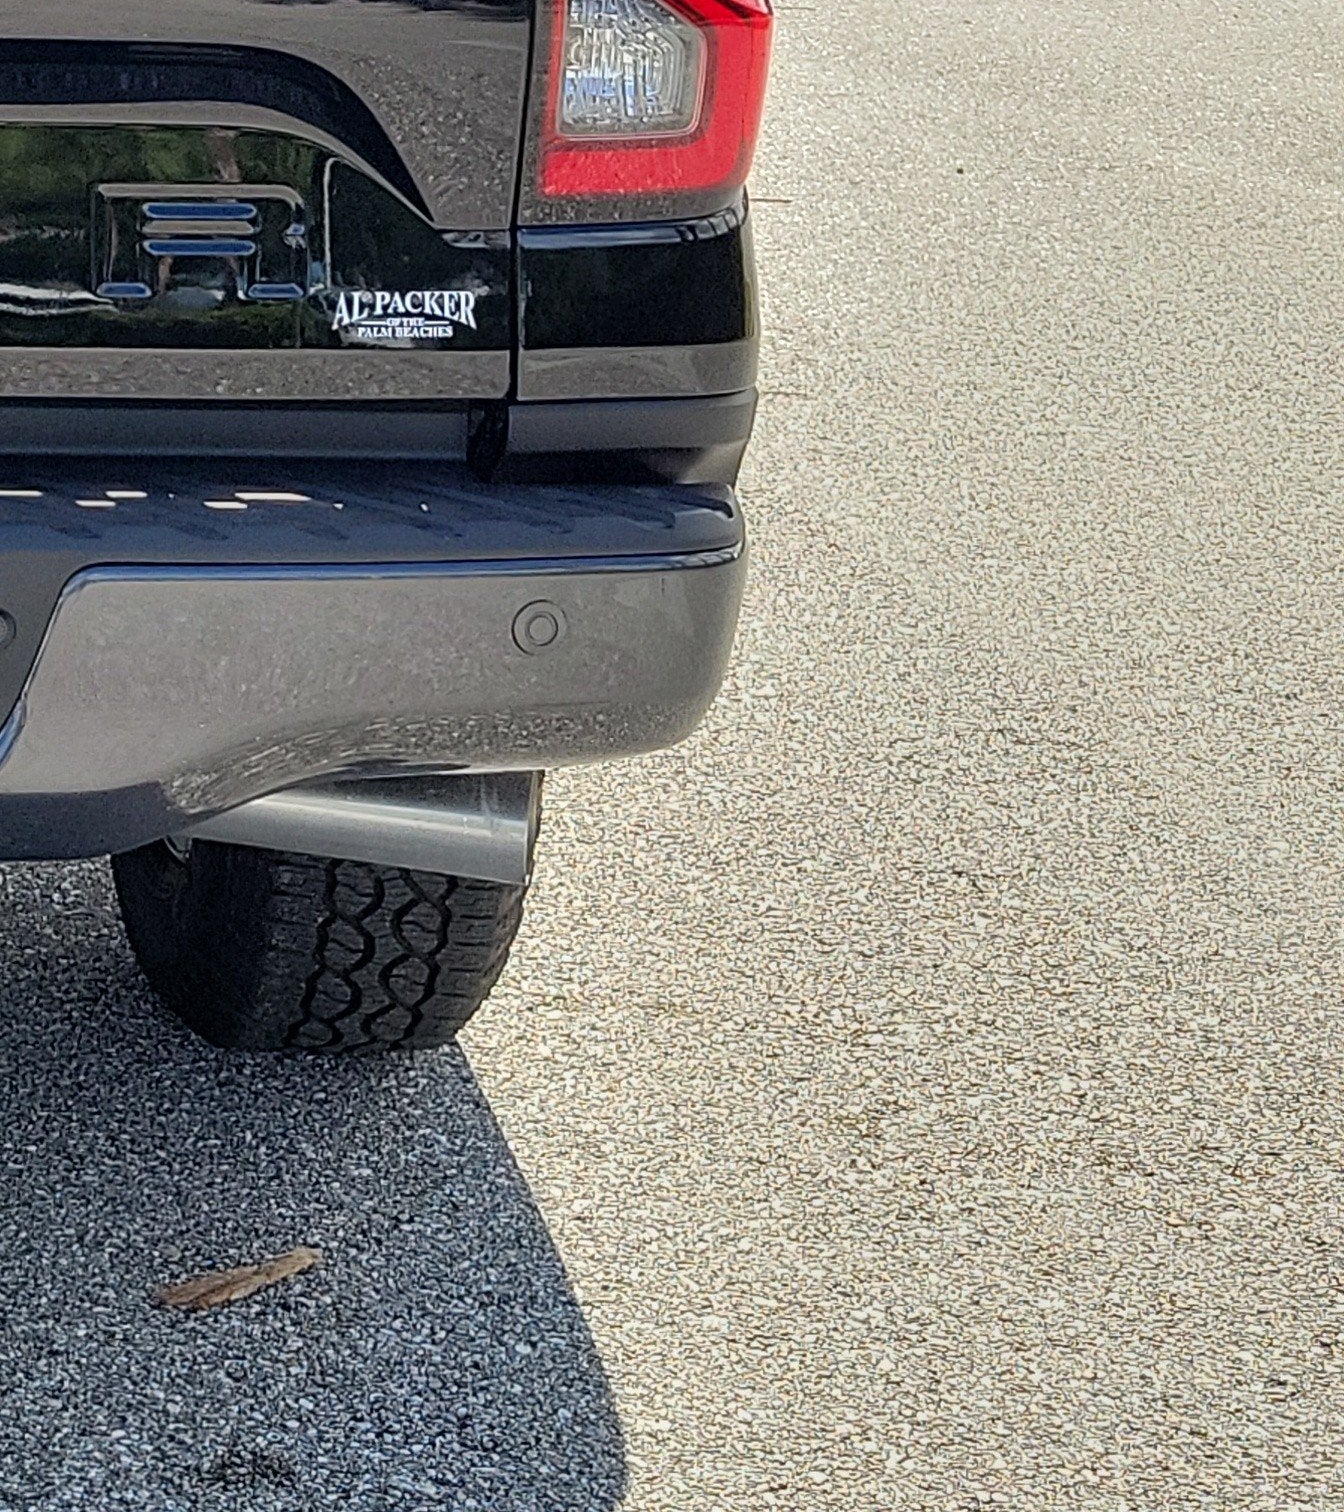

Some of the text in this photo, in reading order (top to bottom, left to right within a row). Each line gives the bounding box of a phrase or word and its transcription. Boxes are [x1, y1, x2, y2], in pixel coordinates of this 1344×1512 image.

[331, 291, 477, 330] AL PACKER
[356, 326, 453, 338] PALM BEACHES
